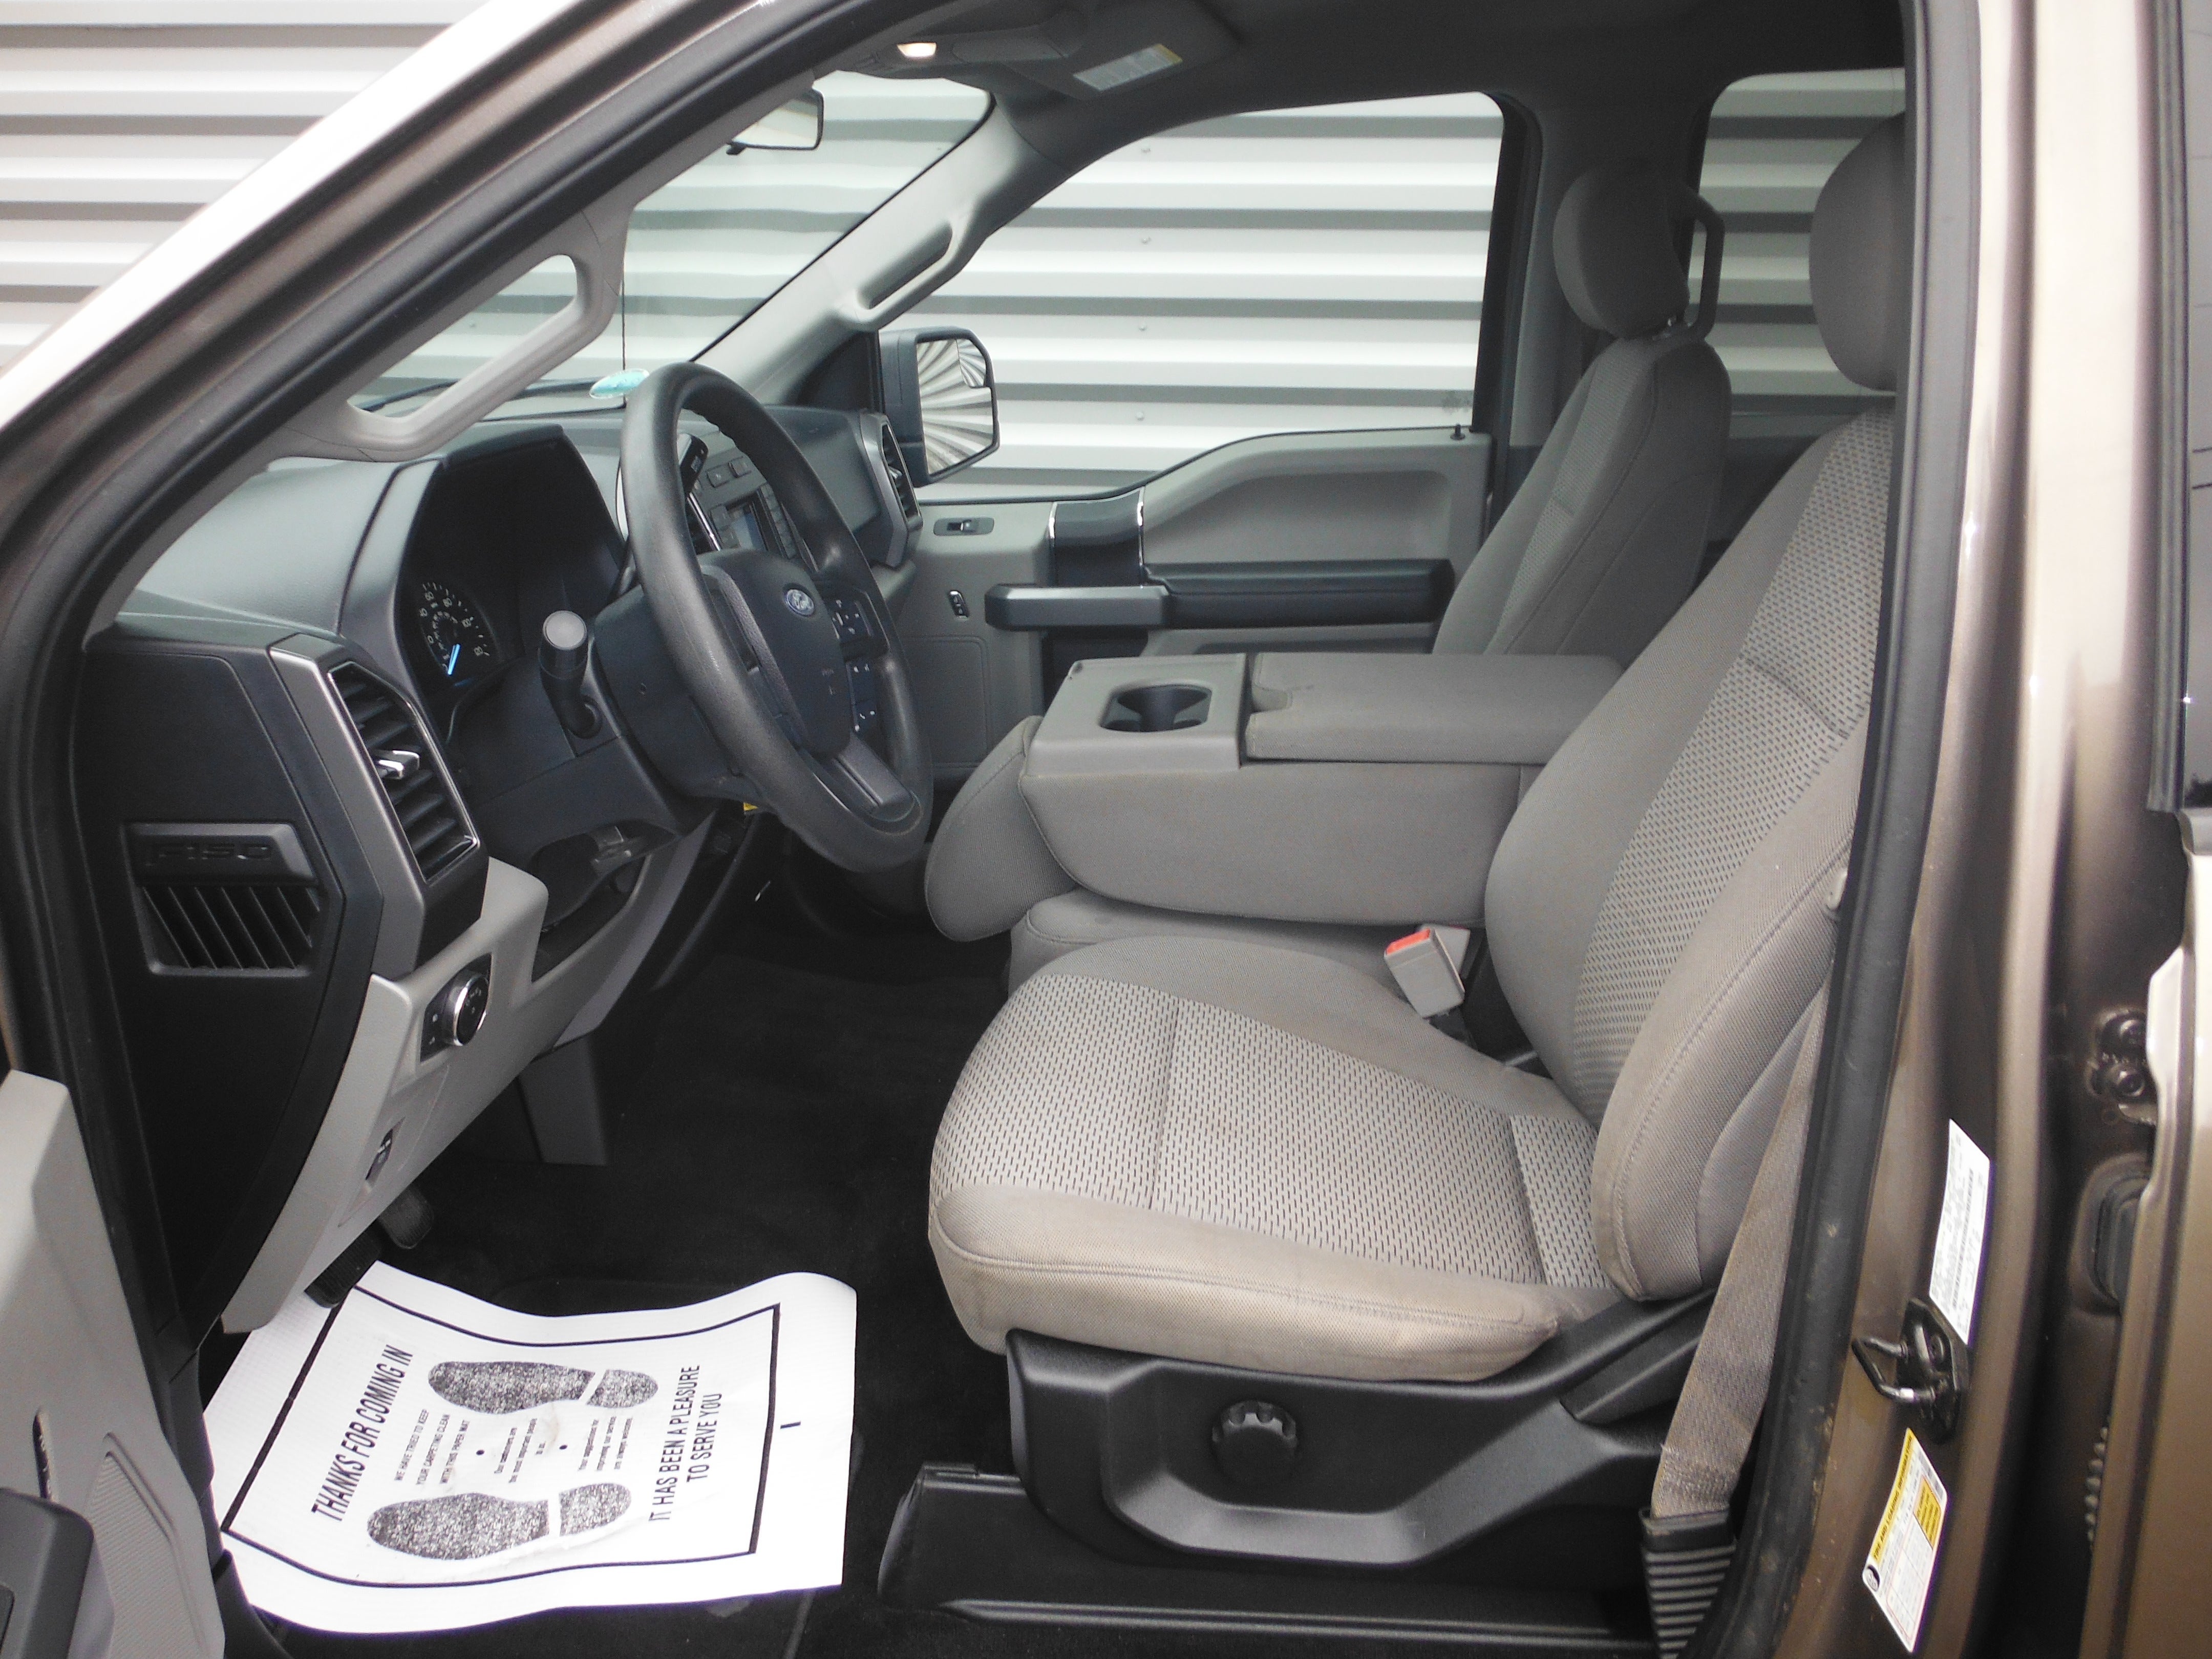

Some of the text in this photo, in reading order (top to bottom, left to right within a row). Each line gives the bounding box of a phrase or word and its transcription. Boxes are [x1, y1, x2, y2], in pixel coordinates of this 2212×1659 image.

[669, 1365, 699, 1425] PLEASURE
[311, 1345, 413, 1521] THANKS FOR COMING IN
[659, 1440, 685, 1472] BEEN
[686, 1393, 722, 1482] TO SERVE YOU
[648, 1512, 671, 1521] IT
[652, 1477, 677, 1505] HAS
[1880, 1524, 1888, 1542] AND
[1885, 1491, 1900, 1526] LOADING
